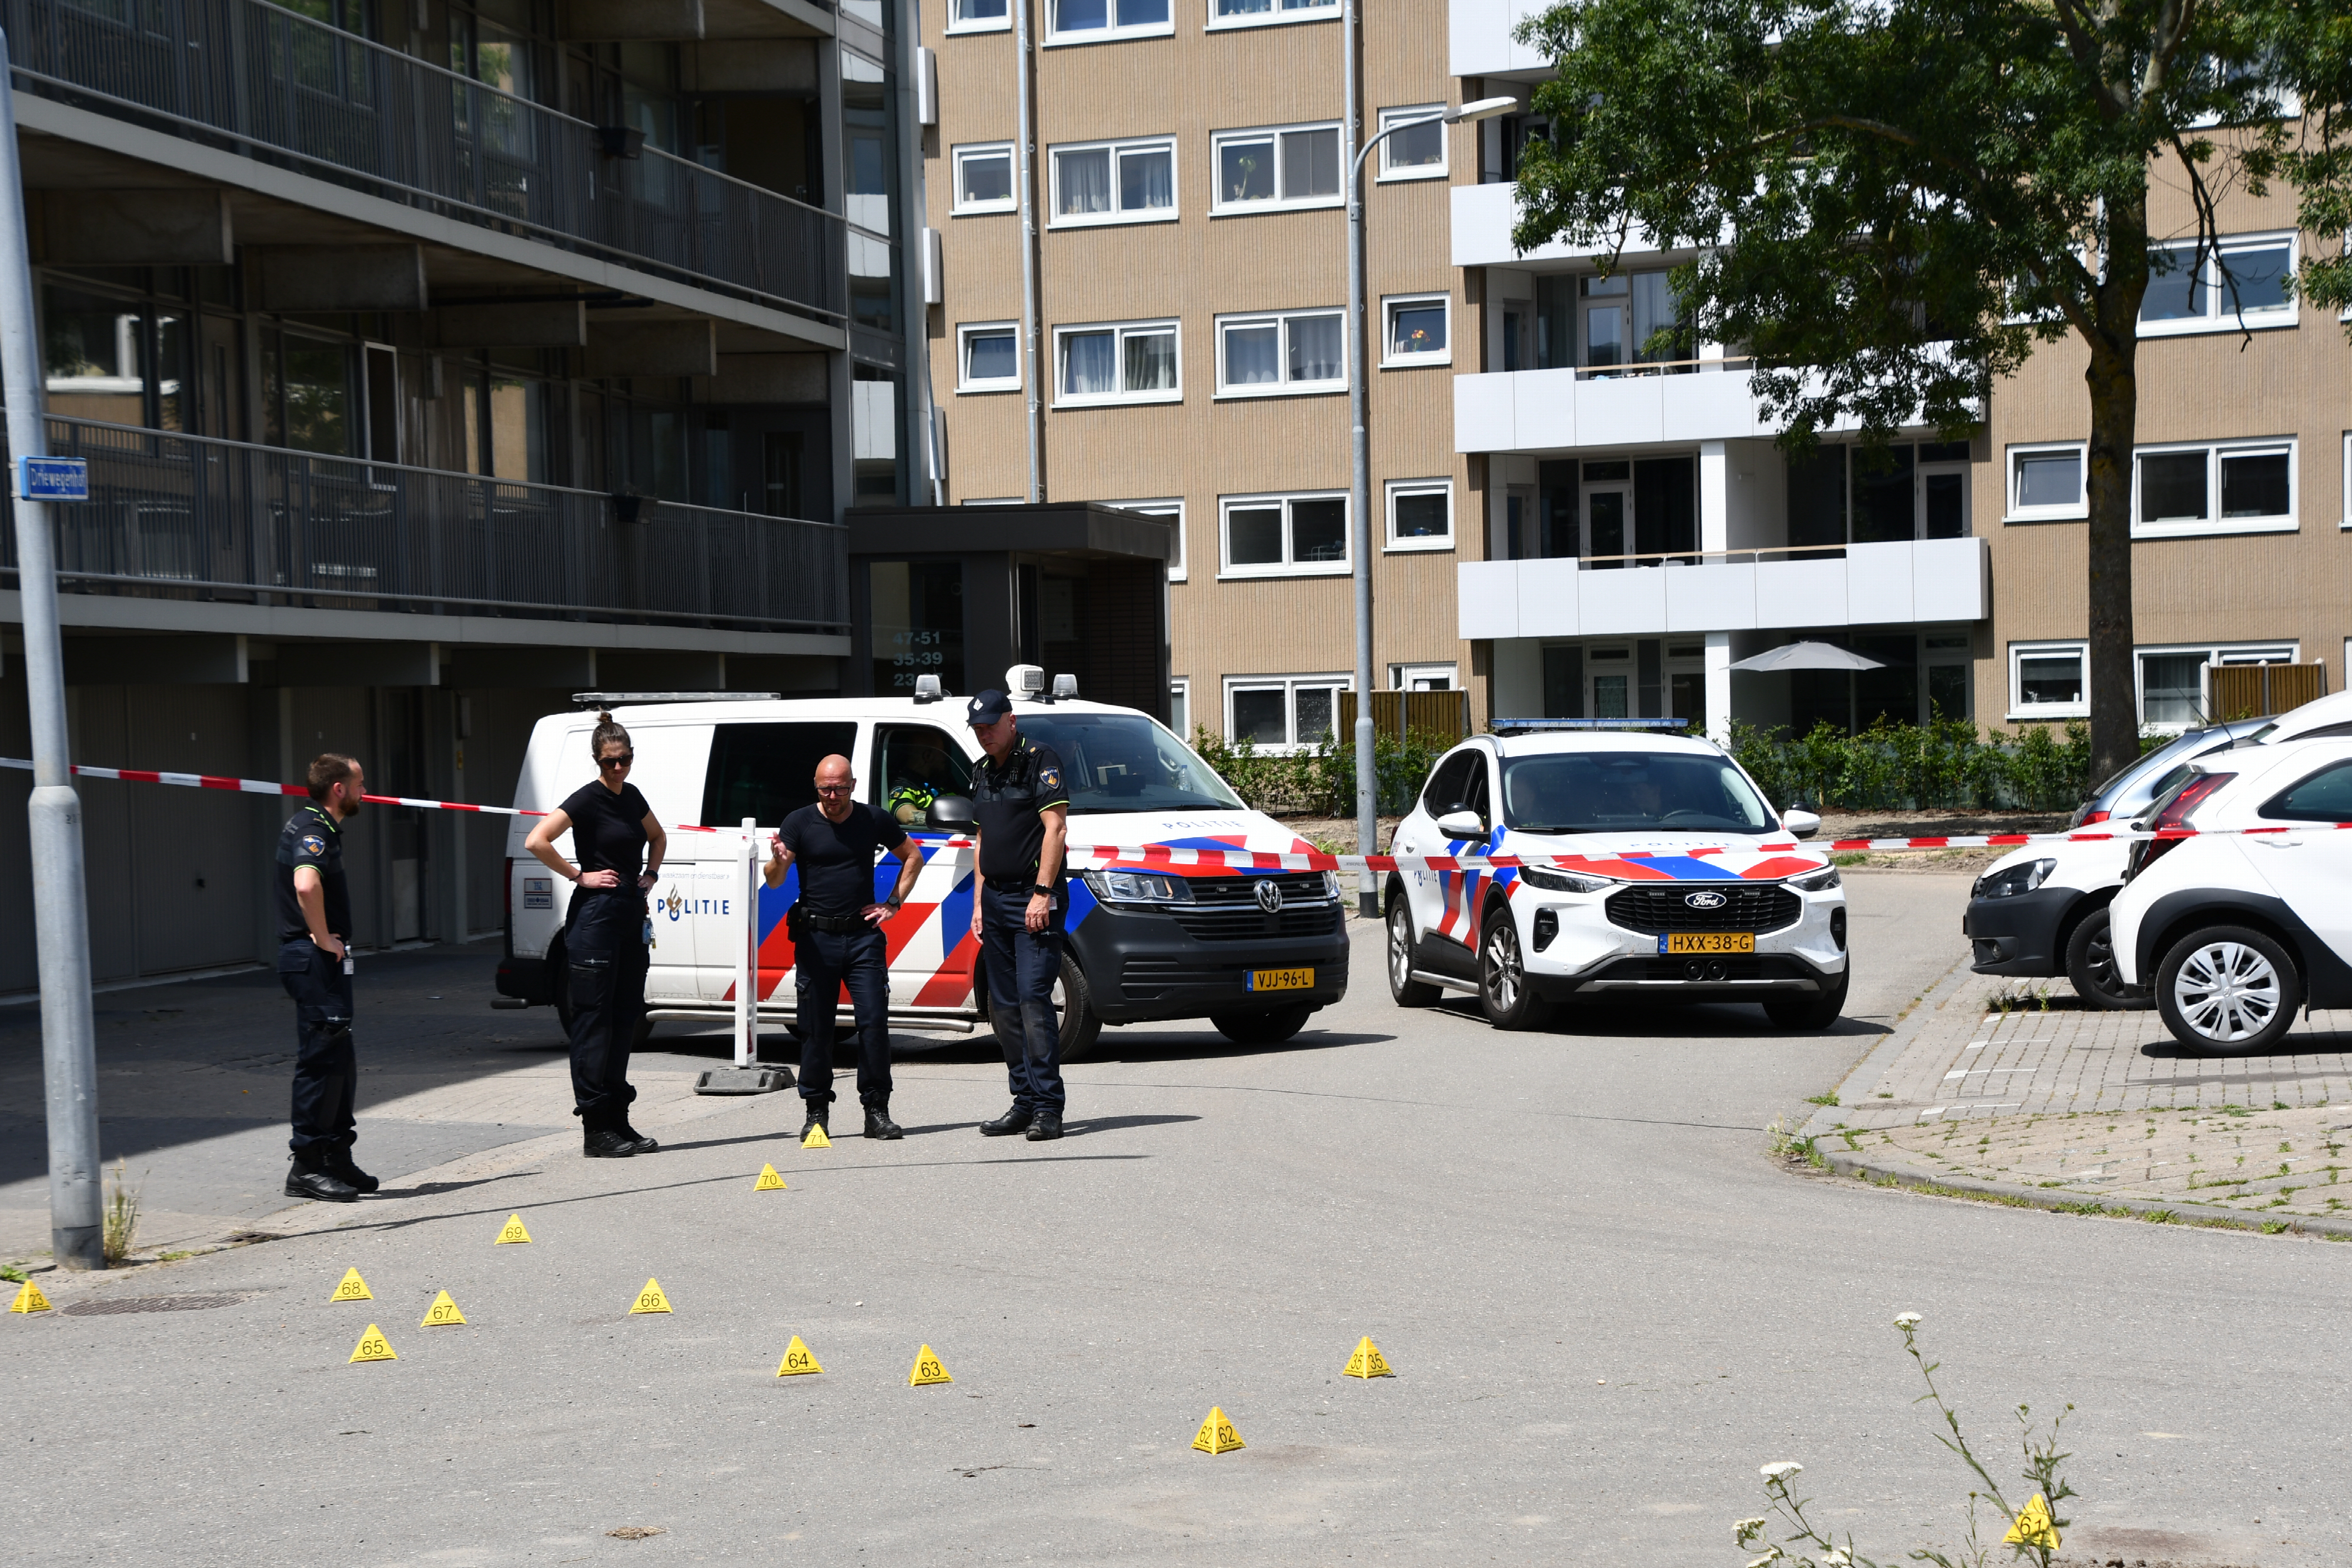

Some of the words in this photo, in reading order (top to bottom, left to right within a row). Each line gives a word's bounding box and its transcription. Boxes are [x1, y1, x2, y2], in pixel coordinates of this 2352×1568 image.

[31, 467, 86, 493] Driewegenhof
[893, 631, 940, 645] 47-51
[893, 651, 943, 666] 35-39
[1161, 821, 1245, 829] POLITIE
[1693, 894, 1719, 906] Ford
[657, 898, 730, 922] POLITIE
[1673, 935, 1749, 951] HXX-38-G
[1258, 971, 1308, 988] VJJ-96-L
[810, 1134, 822, 1144] 71
[761, 1174, 777, 1185] 70
[506, 1226, 522, 1239] 69
[342, 1282, 360, 1295] 68
[29, 1293, 44, 1306] 23
[641, 1293, 660, 1308] 66
[433, 1305, 453, 1320] 67
[362, 1339, 383, 1355] 65
[788, 1352, 809, 1368] 64
[1351, 1353, 1363, 1370] 35
[1368, 1353, 1383, 1370] 35
[921, 1361, 941, 1378] 63
[1200, 1425, 1212, 1445] 62
[1218, 1425, 1236, 1445] 62
[2020, 1516, 2042, 1536] 61
